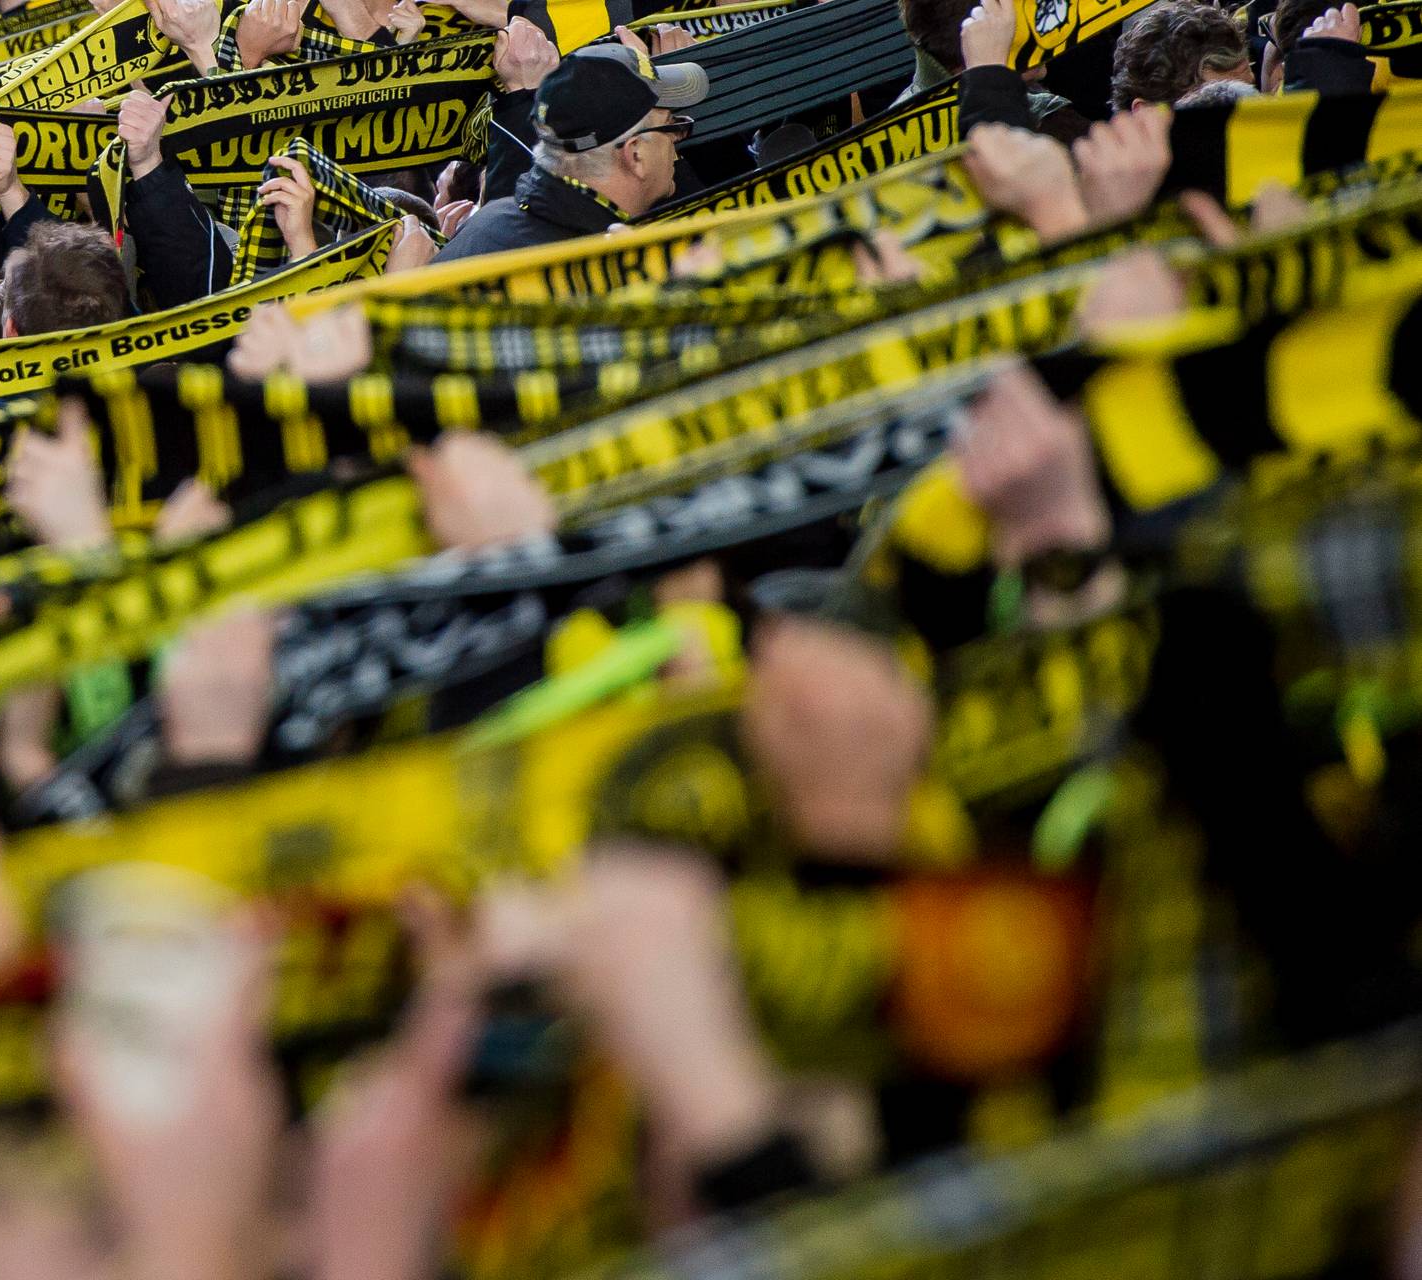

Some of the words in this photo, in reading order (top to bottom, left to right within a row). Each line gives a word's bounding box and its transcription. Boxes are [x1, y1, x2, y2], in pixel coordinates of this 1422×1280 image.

[130, 56, 149, 77] 6x
[250, 101, 319, 124] TRADITION
[323, 87, 411, 112] VERPFLICHTET
[57, 347, 100, 373] ein
[110, 304, 253, 357] Borusse
